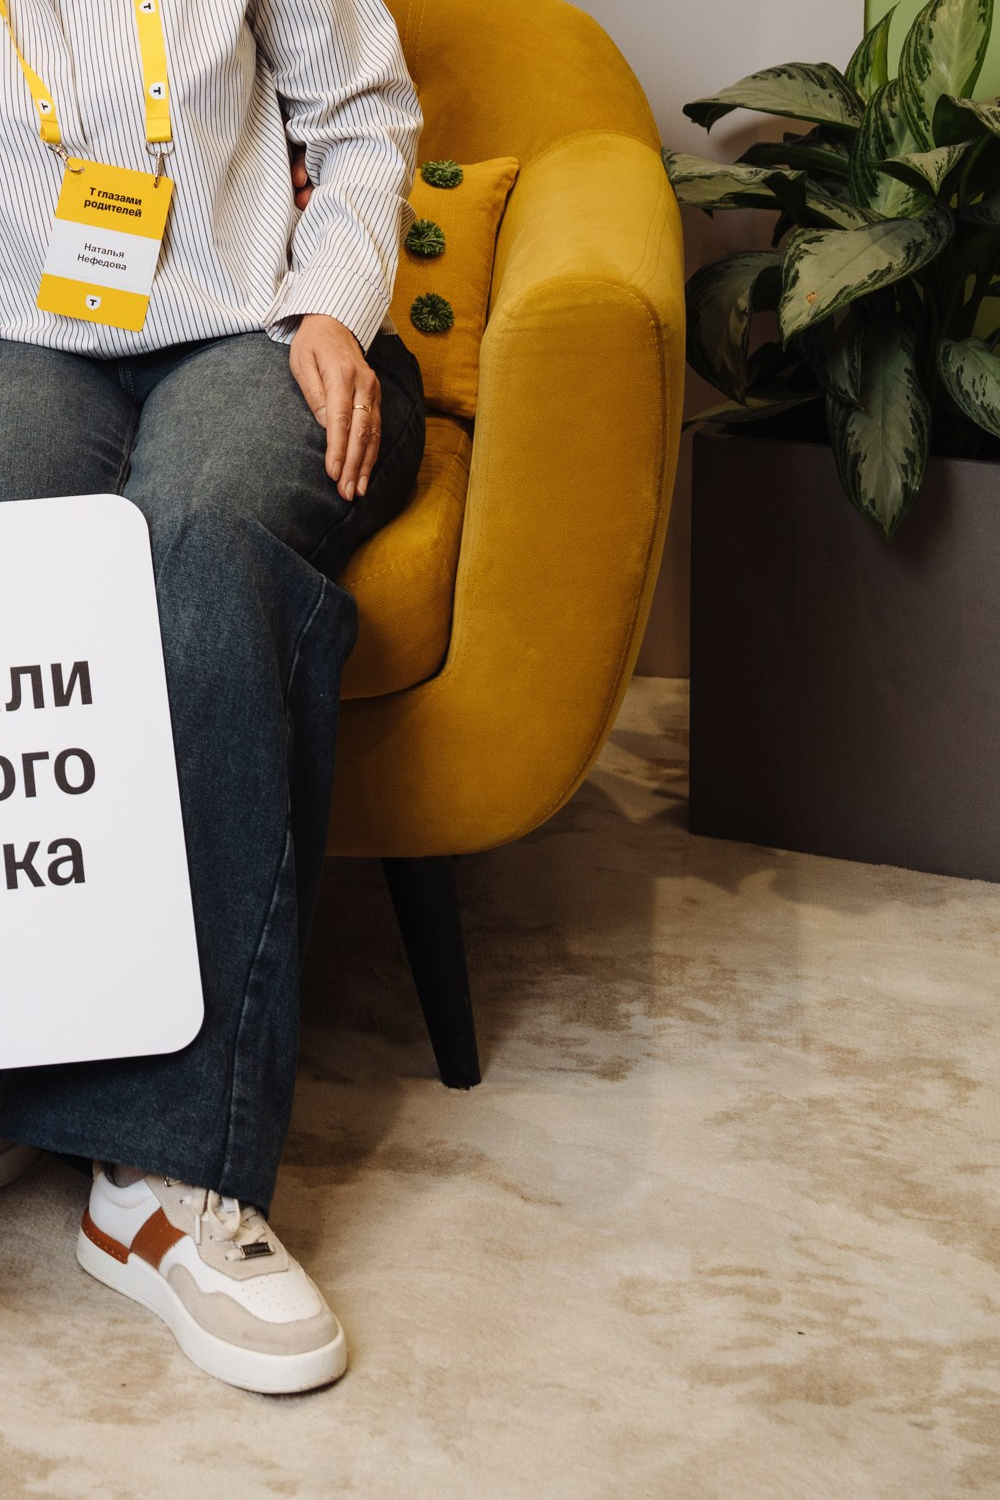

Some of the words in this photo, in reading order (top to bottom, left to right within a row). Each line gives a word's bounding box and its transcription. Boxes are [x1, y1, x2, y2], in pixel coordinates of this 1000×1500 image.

[89, 187, 97, 196] Т
[97, 190, 142, 206] глазами
[83, 199, 142, 218] родителей
[83, 243, 125, 258] Наталья
[77, 253, 127, 271] Нефедова
